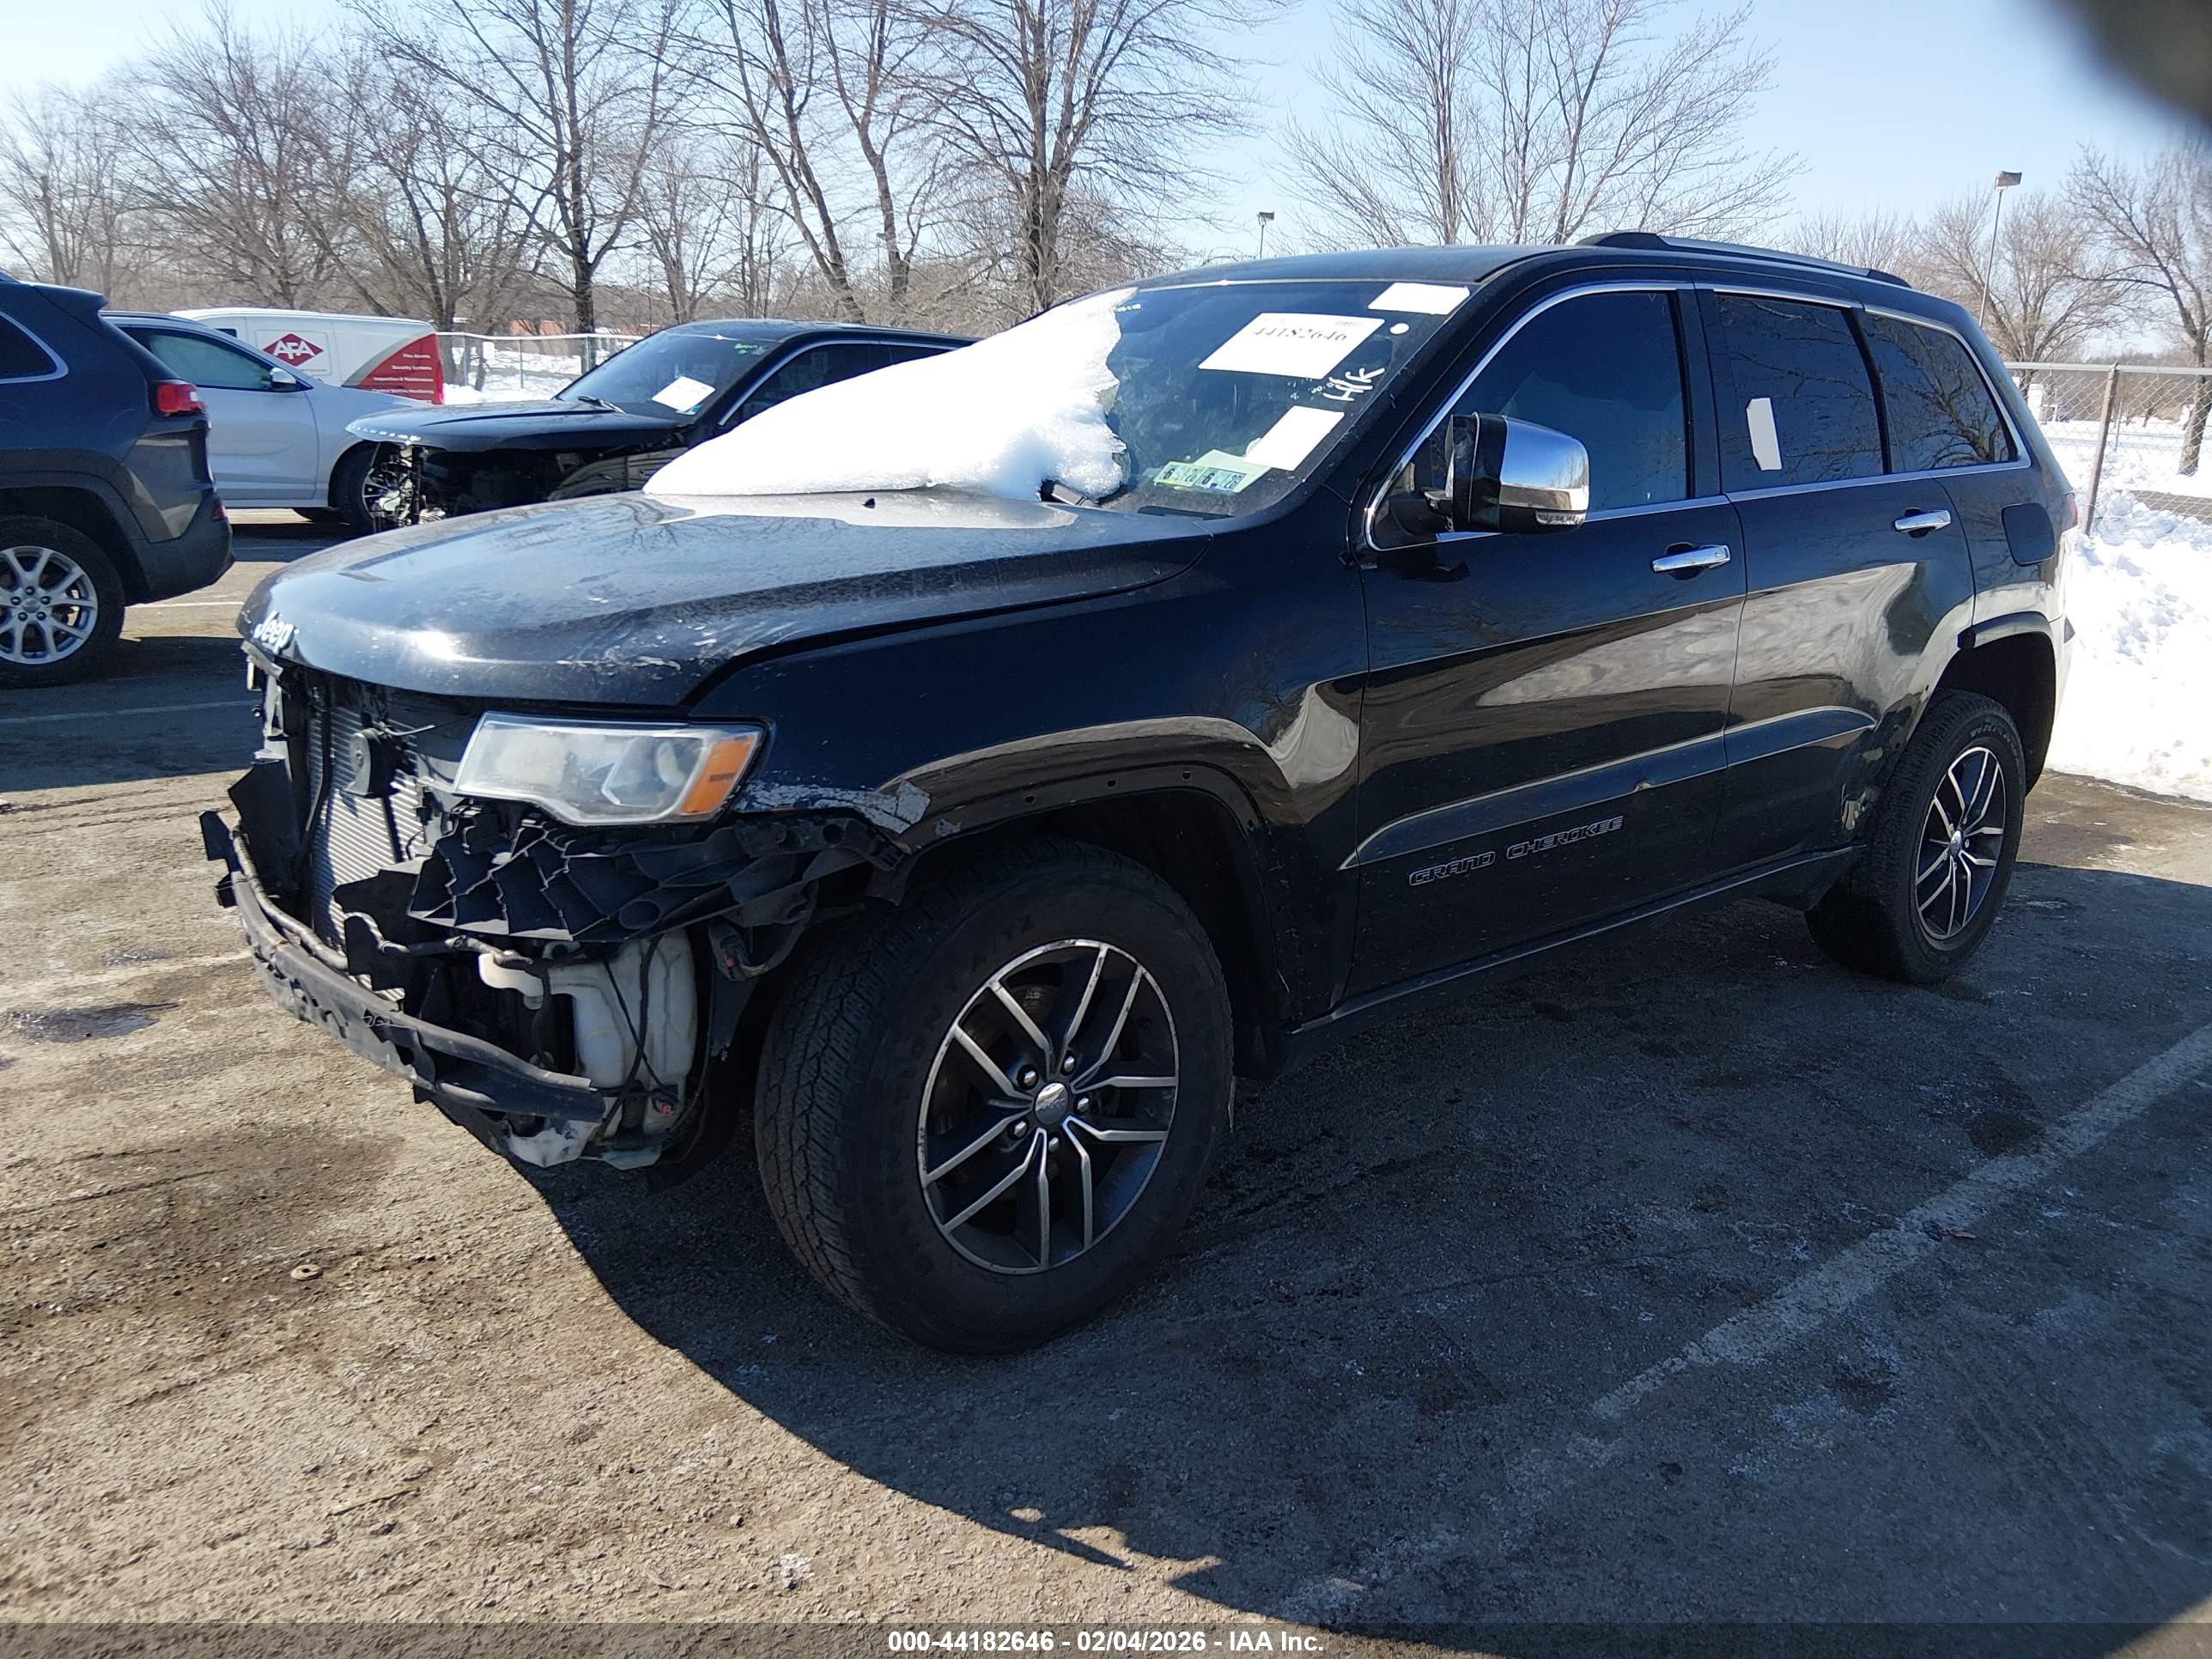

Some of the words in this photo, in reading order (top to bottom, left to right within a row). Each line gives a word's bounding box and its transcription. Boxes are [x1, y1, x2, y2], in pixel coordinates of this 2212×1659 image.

[273, 340, 315, 360] AFA
[1253, 327, 1348, 342] 44182646
[253, 611, 295, 653] Jeep
[1409, 851, 1497, 886] GRAND
[1506, 815, 1624, 860] CHEROKEE
